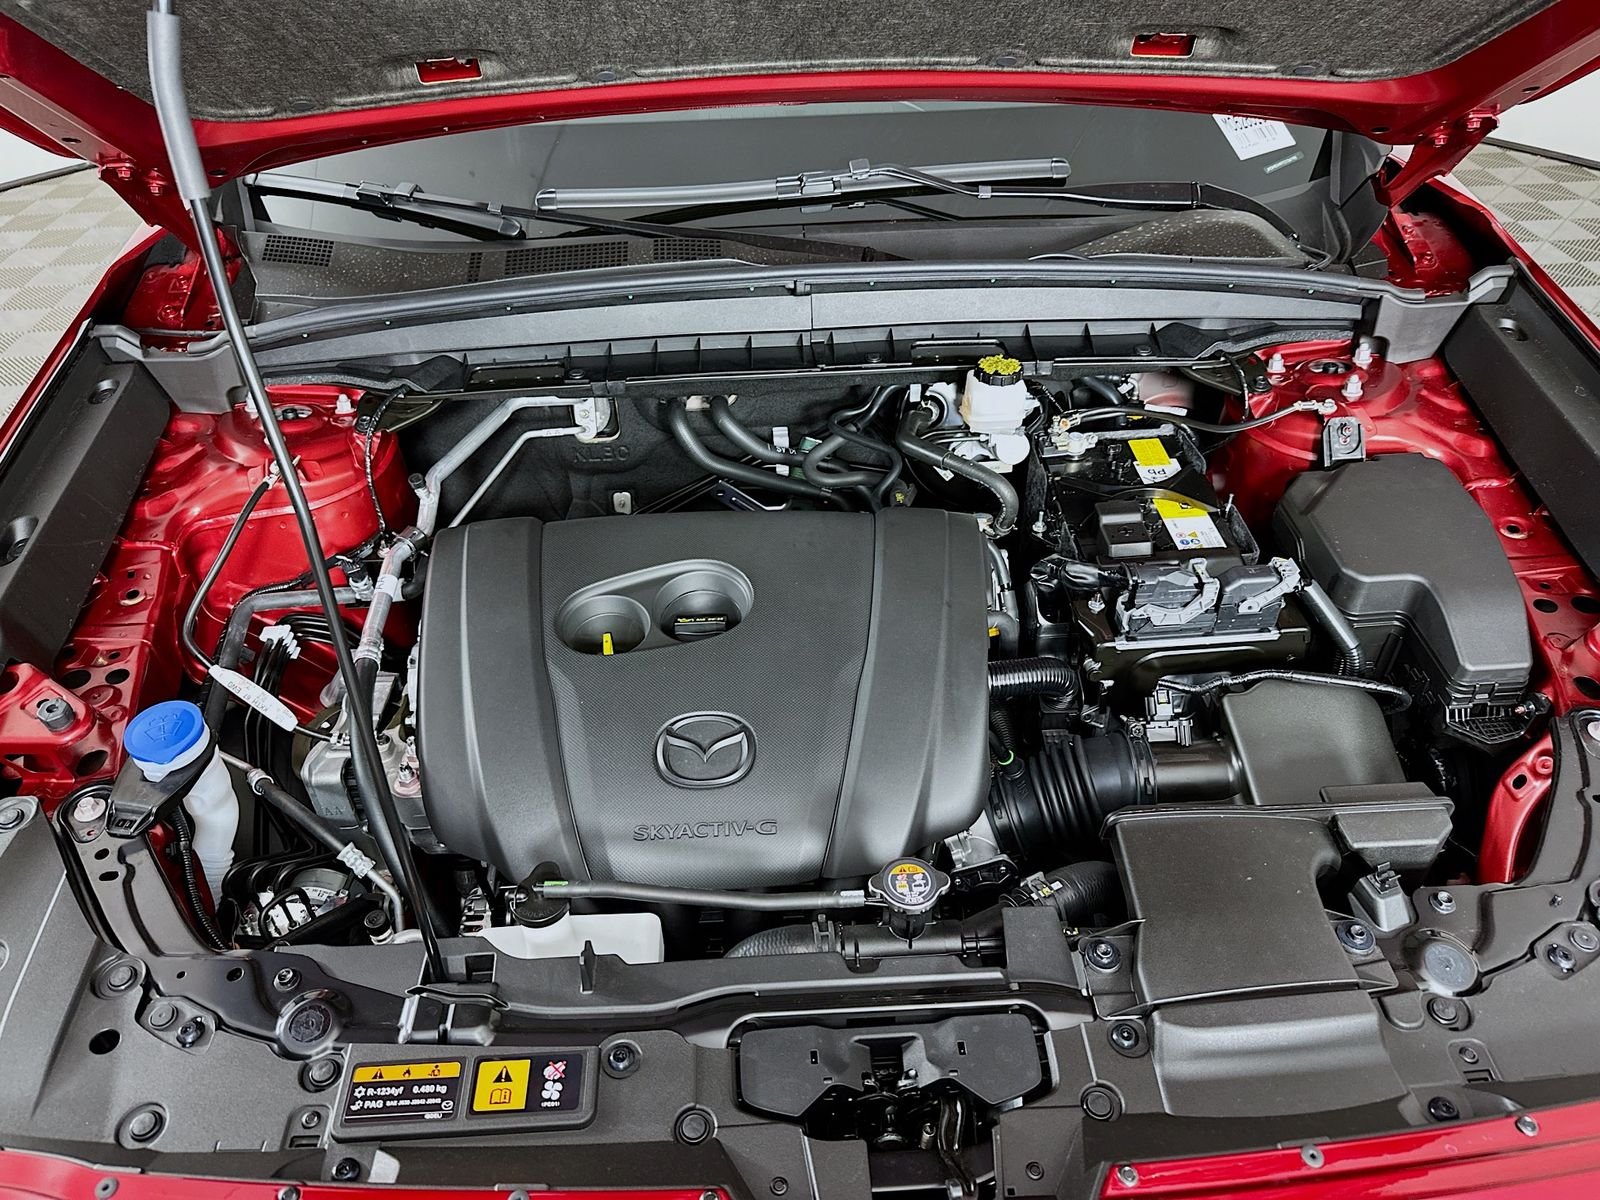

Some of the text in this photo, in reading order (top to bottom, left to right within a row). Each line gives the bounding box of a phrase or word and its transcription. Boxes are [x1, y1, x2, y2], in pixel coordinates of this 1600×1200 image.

[633, 818, 778, 842] SKYACTIV-G
[366, 1086, 404, 1096] R-1234yf
[436, 1085, 448, 1094] kg
[363, 1100, 383, 1109] PAG
